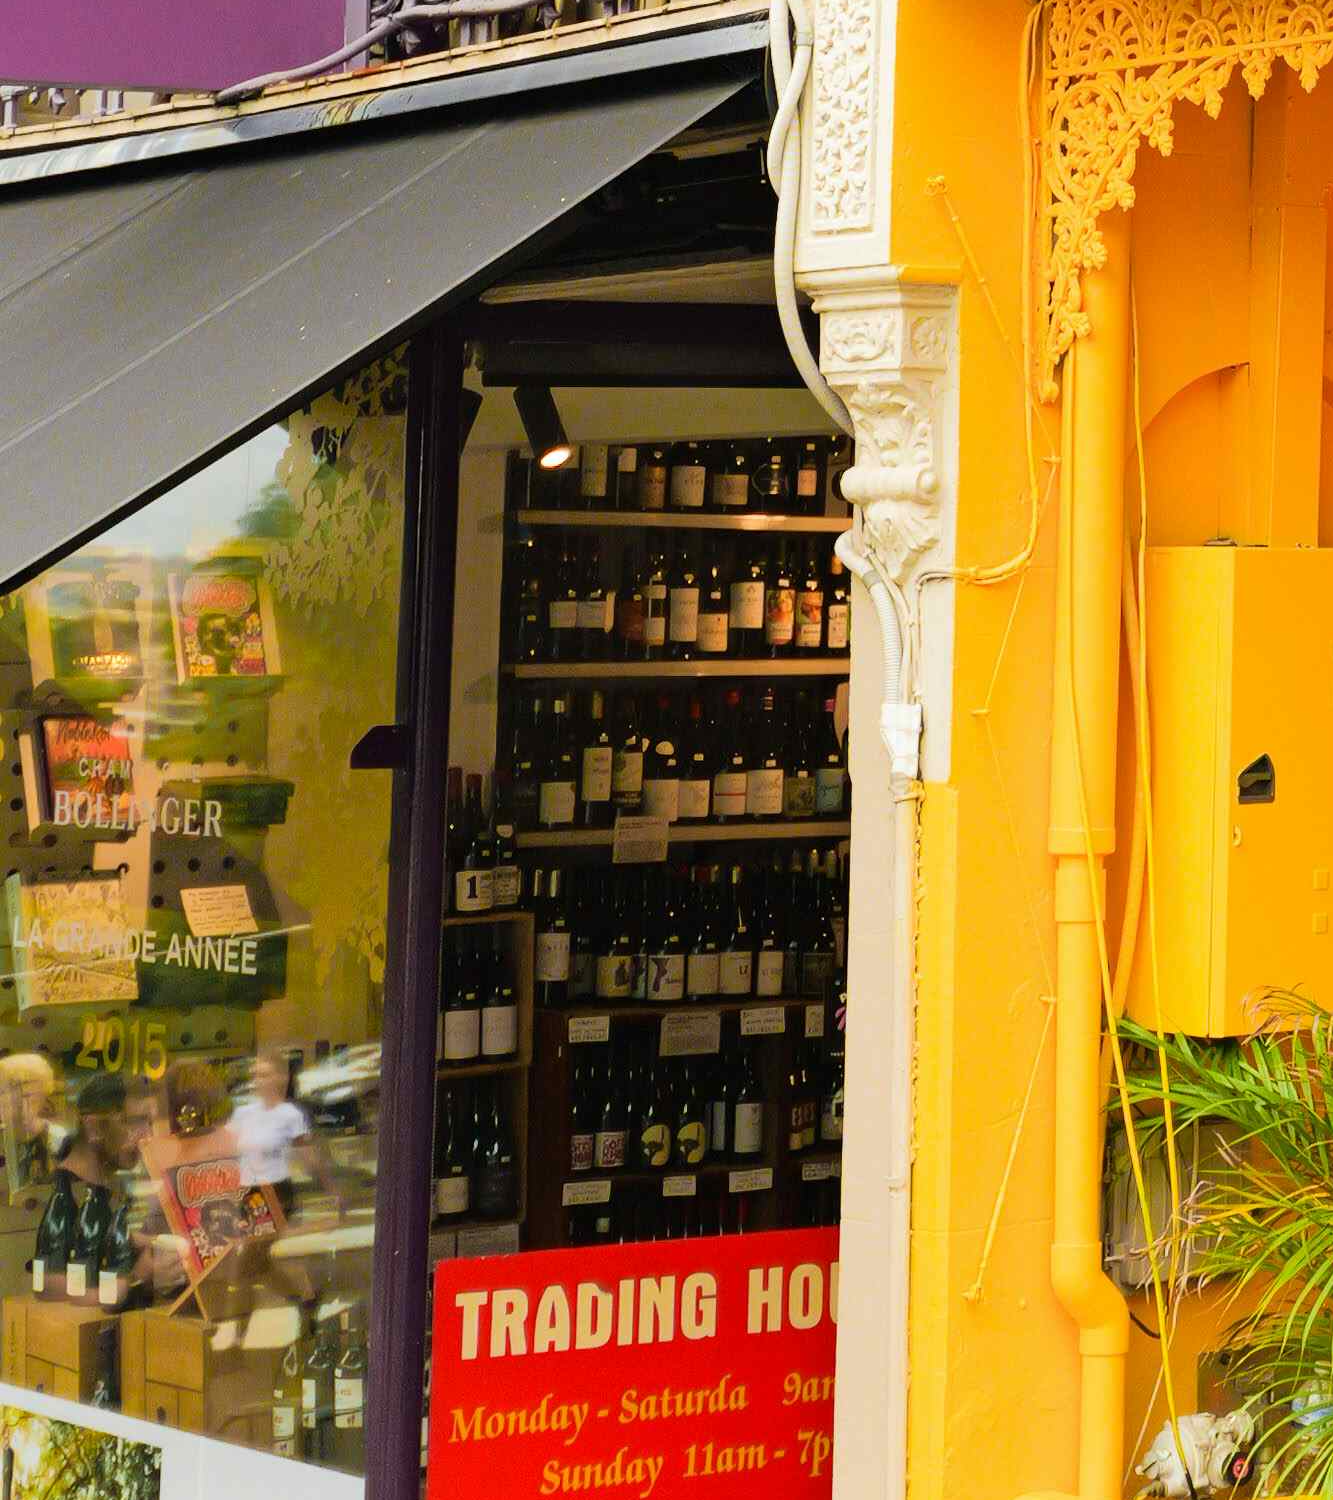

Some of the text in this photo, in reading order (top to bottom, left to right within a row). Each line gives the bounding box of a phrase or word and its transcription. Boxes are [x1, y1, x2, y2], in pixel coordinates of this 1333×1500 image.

[13, 916, 44, 949] LA
[164, 933, 258, 976] ANNÉE
[76, 1013, 167, 1081] 2015
[455, 1261, 839, 1360] TRADING HO
[449, 1393, 589, 1445] Monday
[540, 1446, 663, 1499] Sunday
[797, 1430, 834, 1477] 7p
